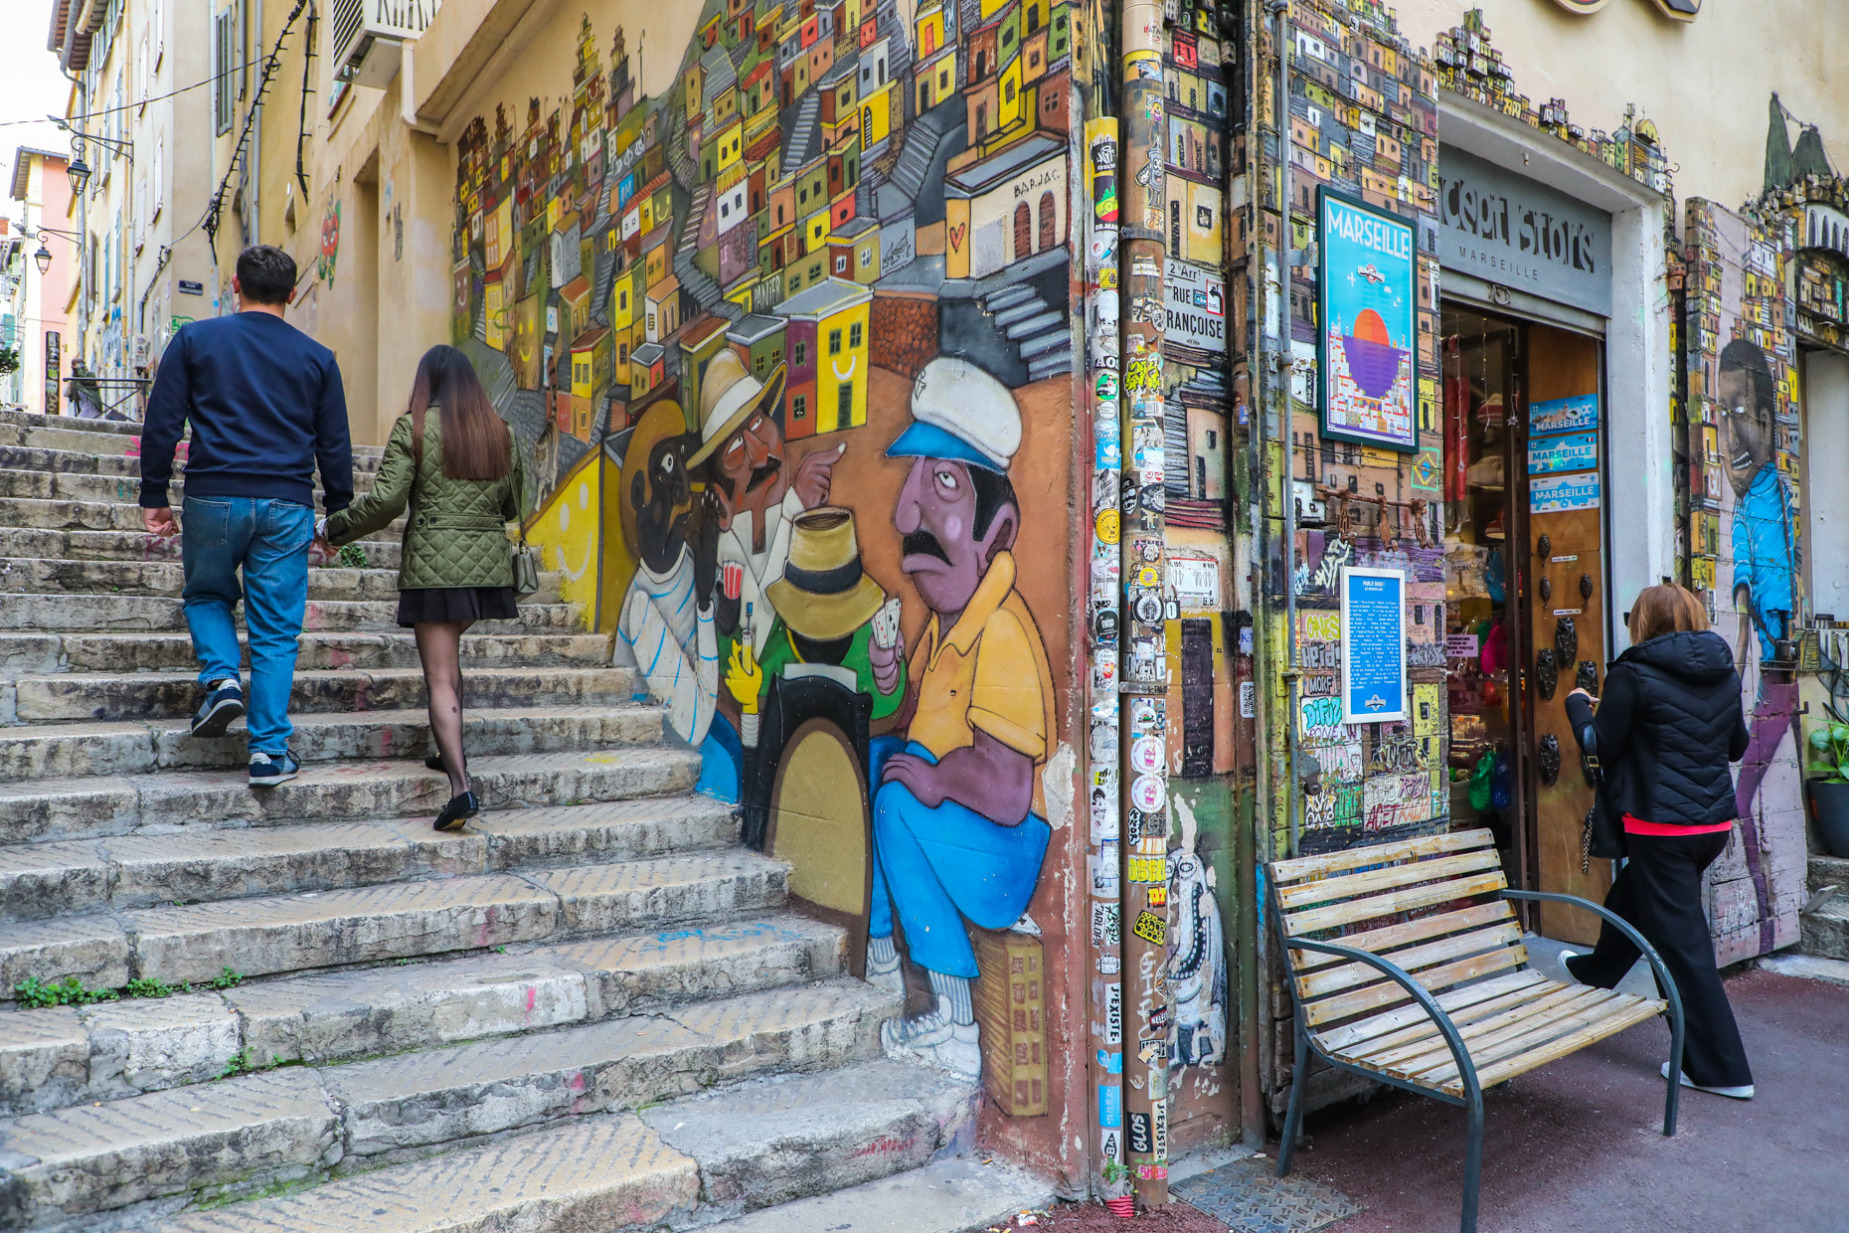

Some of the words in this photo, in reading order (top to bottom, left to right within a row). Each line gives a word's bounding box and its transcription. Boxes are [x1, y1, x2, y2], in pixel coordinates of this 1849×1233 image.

[1327, 203, 1409, 261] MARSEILLE
[1459, 246, 1538, 281] MARSEILLE
[1173, 285, 1191, 304] RUE
[1163, 308, 1223, 340] RANÇOISE
[1535, 416, 1590, 432] MARSEILLE
[1532, 446, 1592, 461] MARSEILLE
[1535, 486, 1594, 501] MARSEILLE
